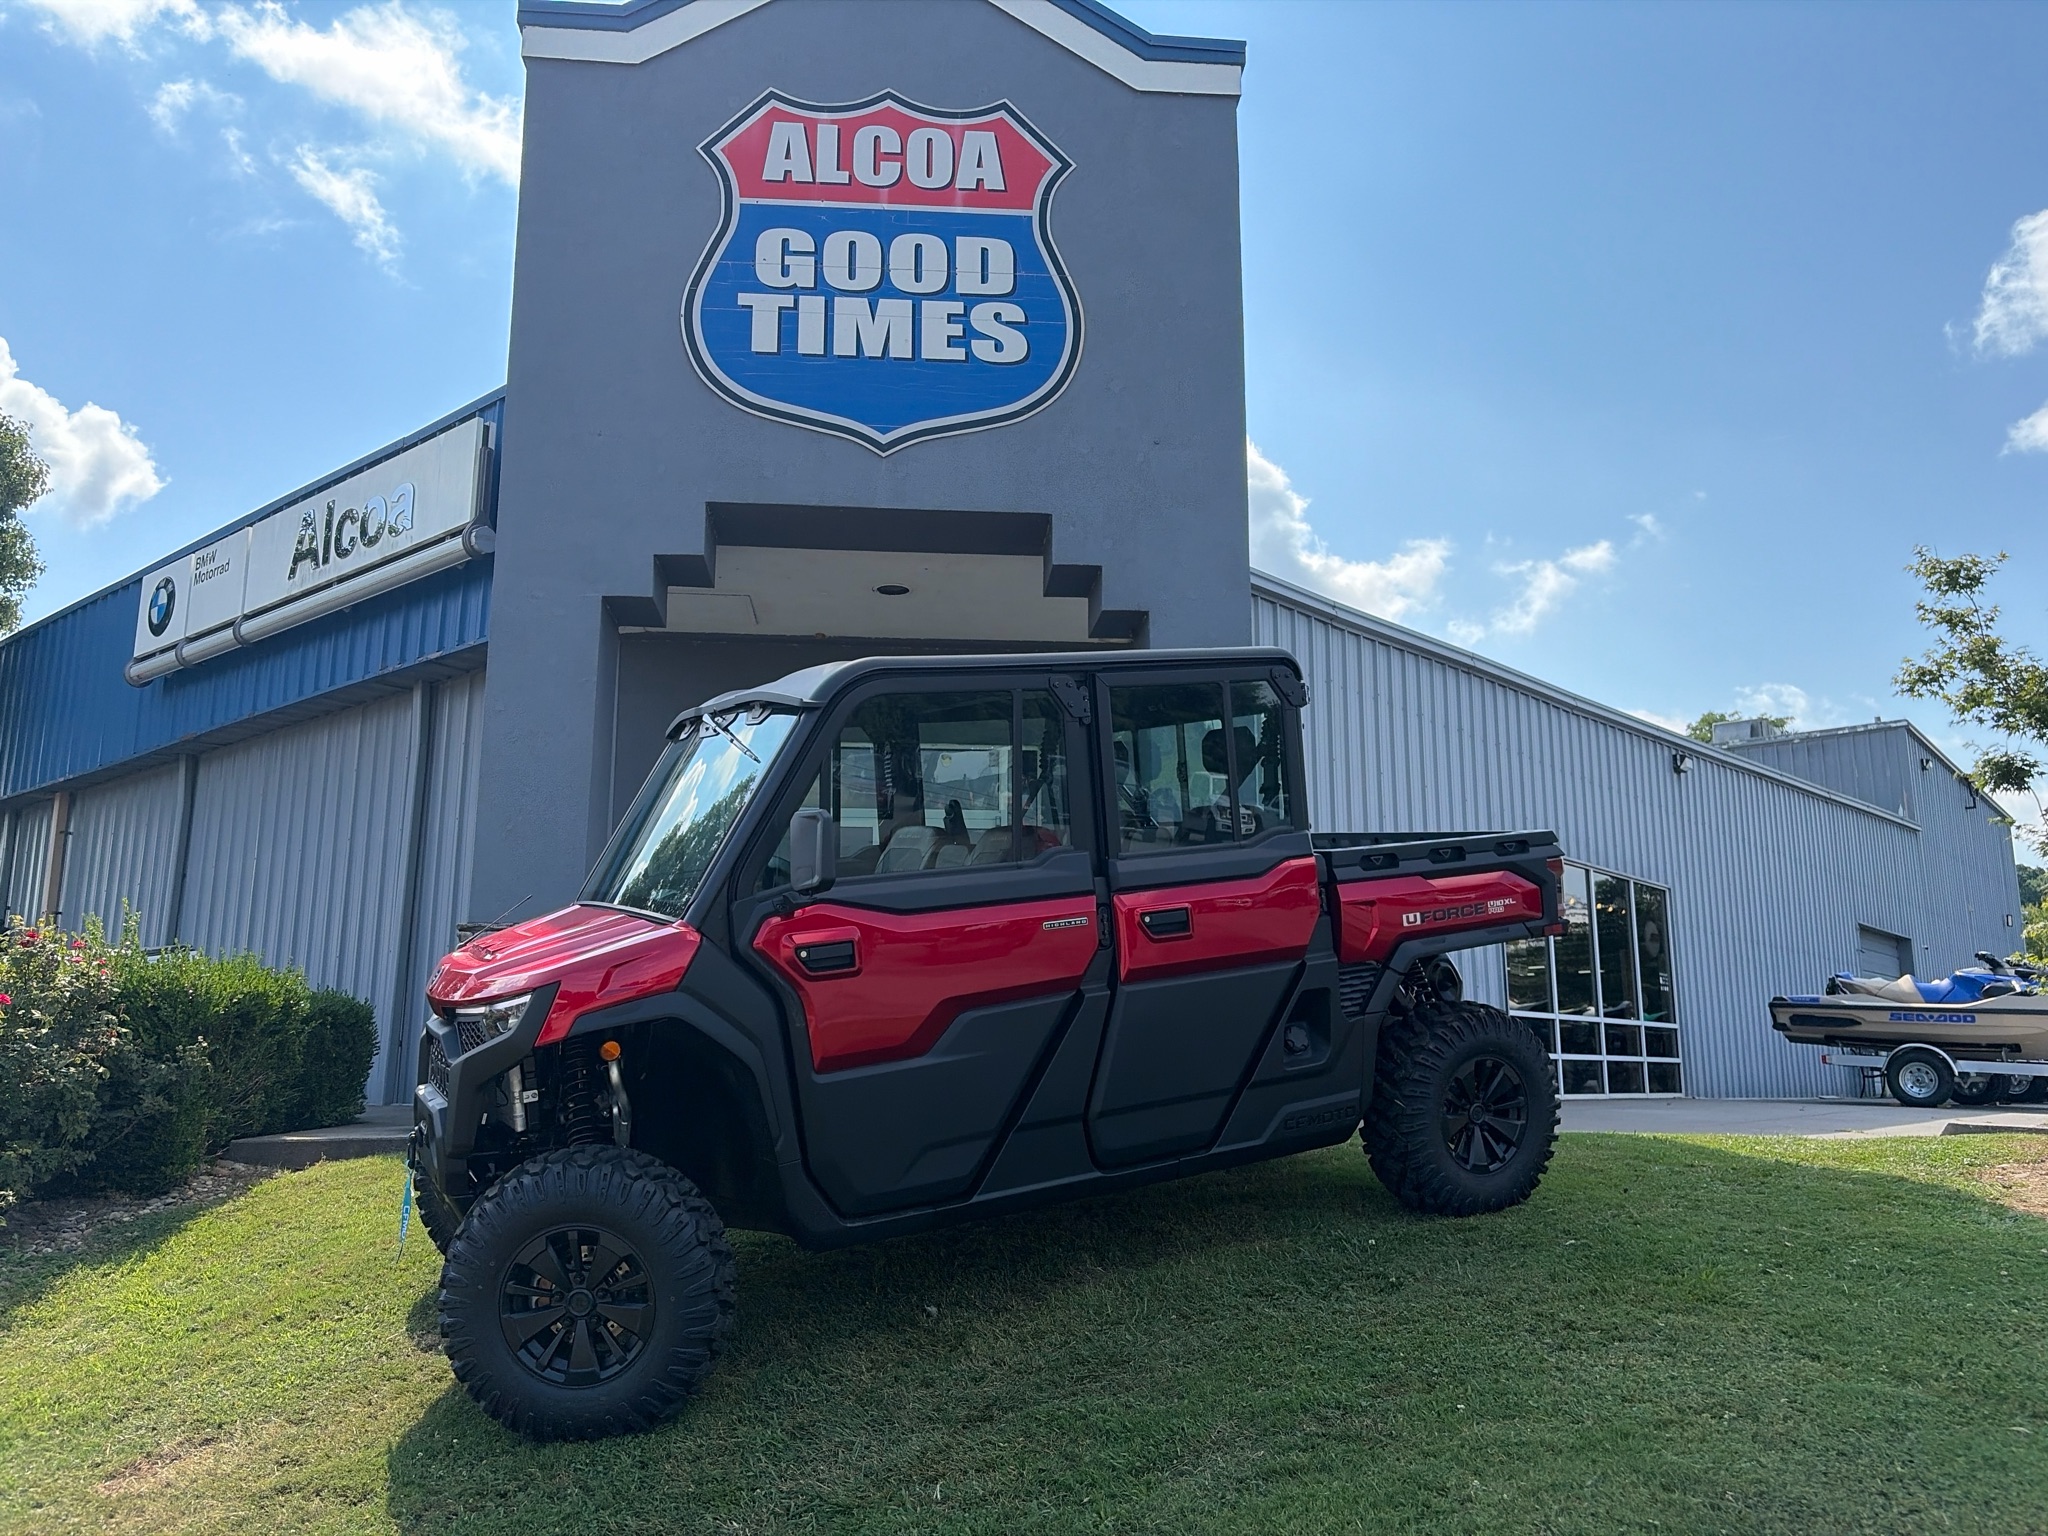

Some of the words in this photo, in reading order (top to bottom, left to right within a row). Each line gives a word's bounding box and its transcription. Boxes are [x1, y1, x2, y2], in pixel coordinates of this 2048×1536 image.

[762, 121, 1007, 192] ALCOA
[754, 228, 1016, 296] GOOD
[737, 292, 1030, 364] TIMES
[195, 549, 217, 571] BMW
[288, 482, 415, 580] Alcoa
[193, 557, 231, 586] Motorrad
[1045, 919, 1087, 929] HIGHLAND
